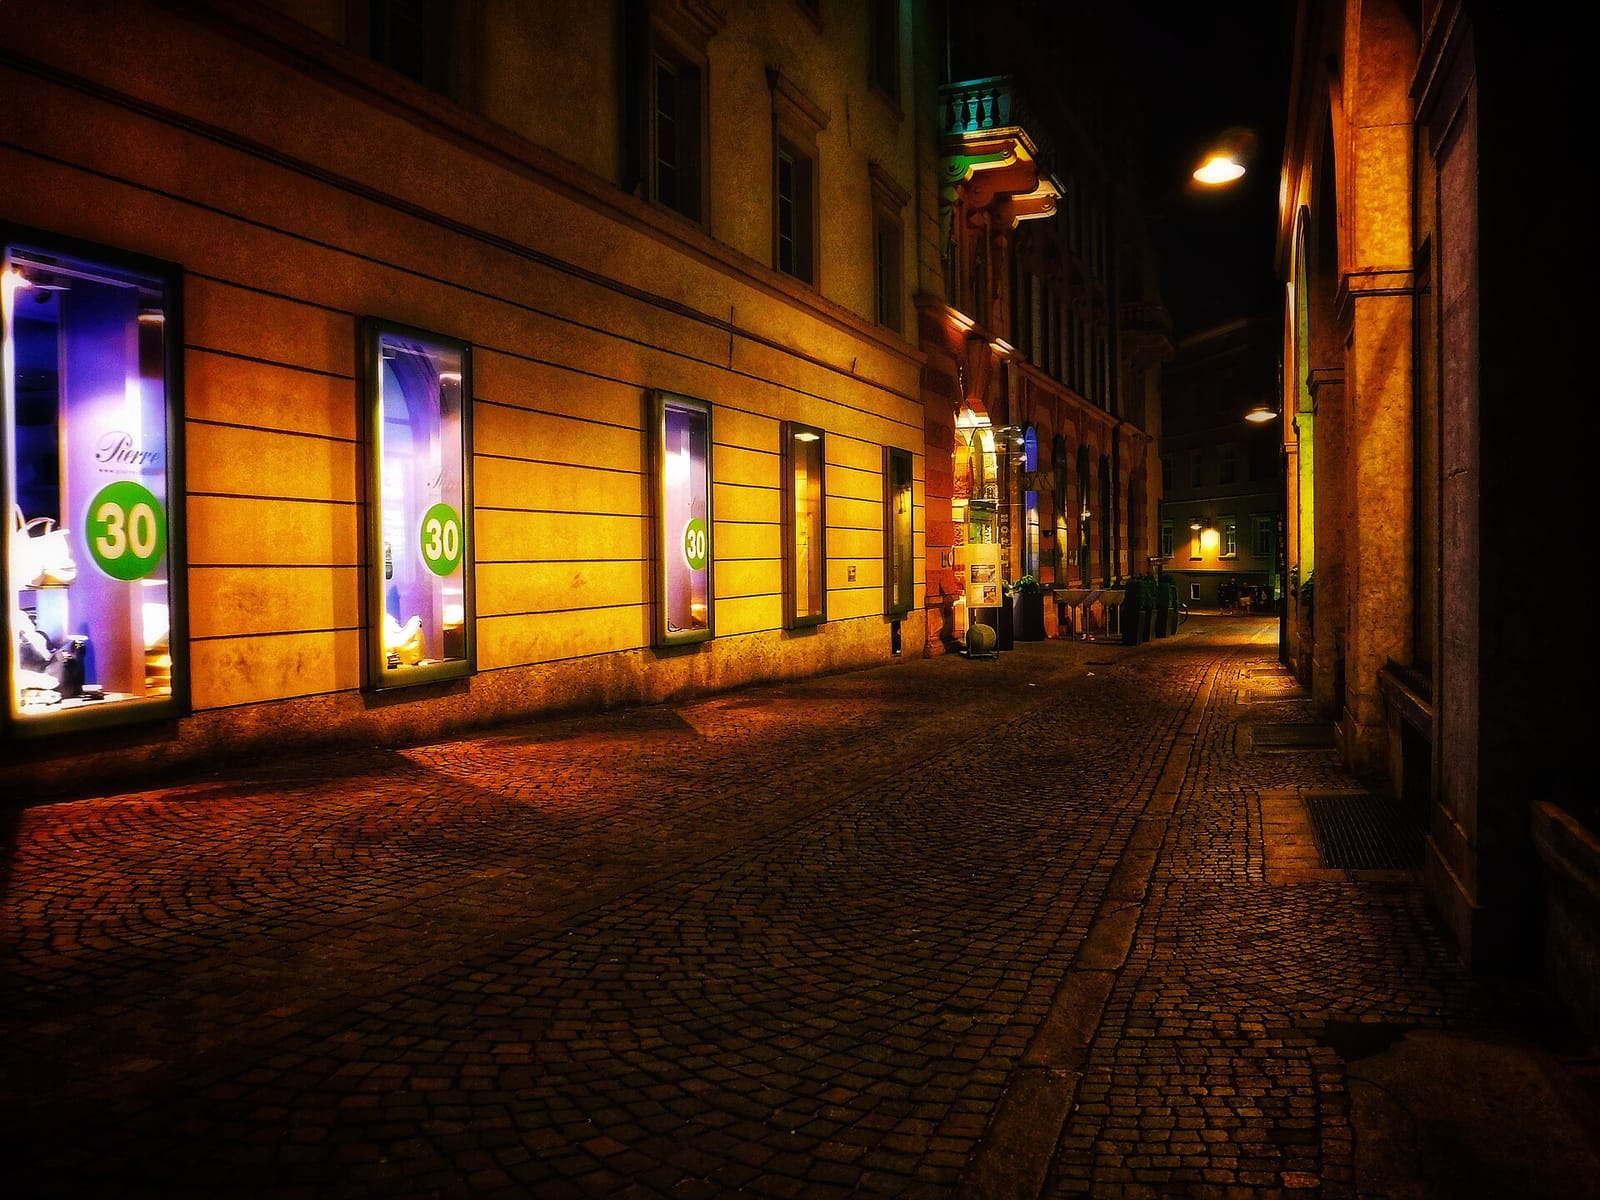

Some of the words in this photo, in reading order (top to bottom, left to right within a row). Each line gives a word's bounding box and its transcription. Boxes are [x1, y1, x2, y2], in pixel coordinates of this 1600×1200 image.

[95, 502, 157, 560] 30
[426, 518, 459, 561] 30
[687, 529, 706, 560] 30
